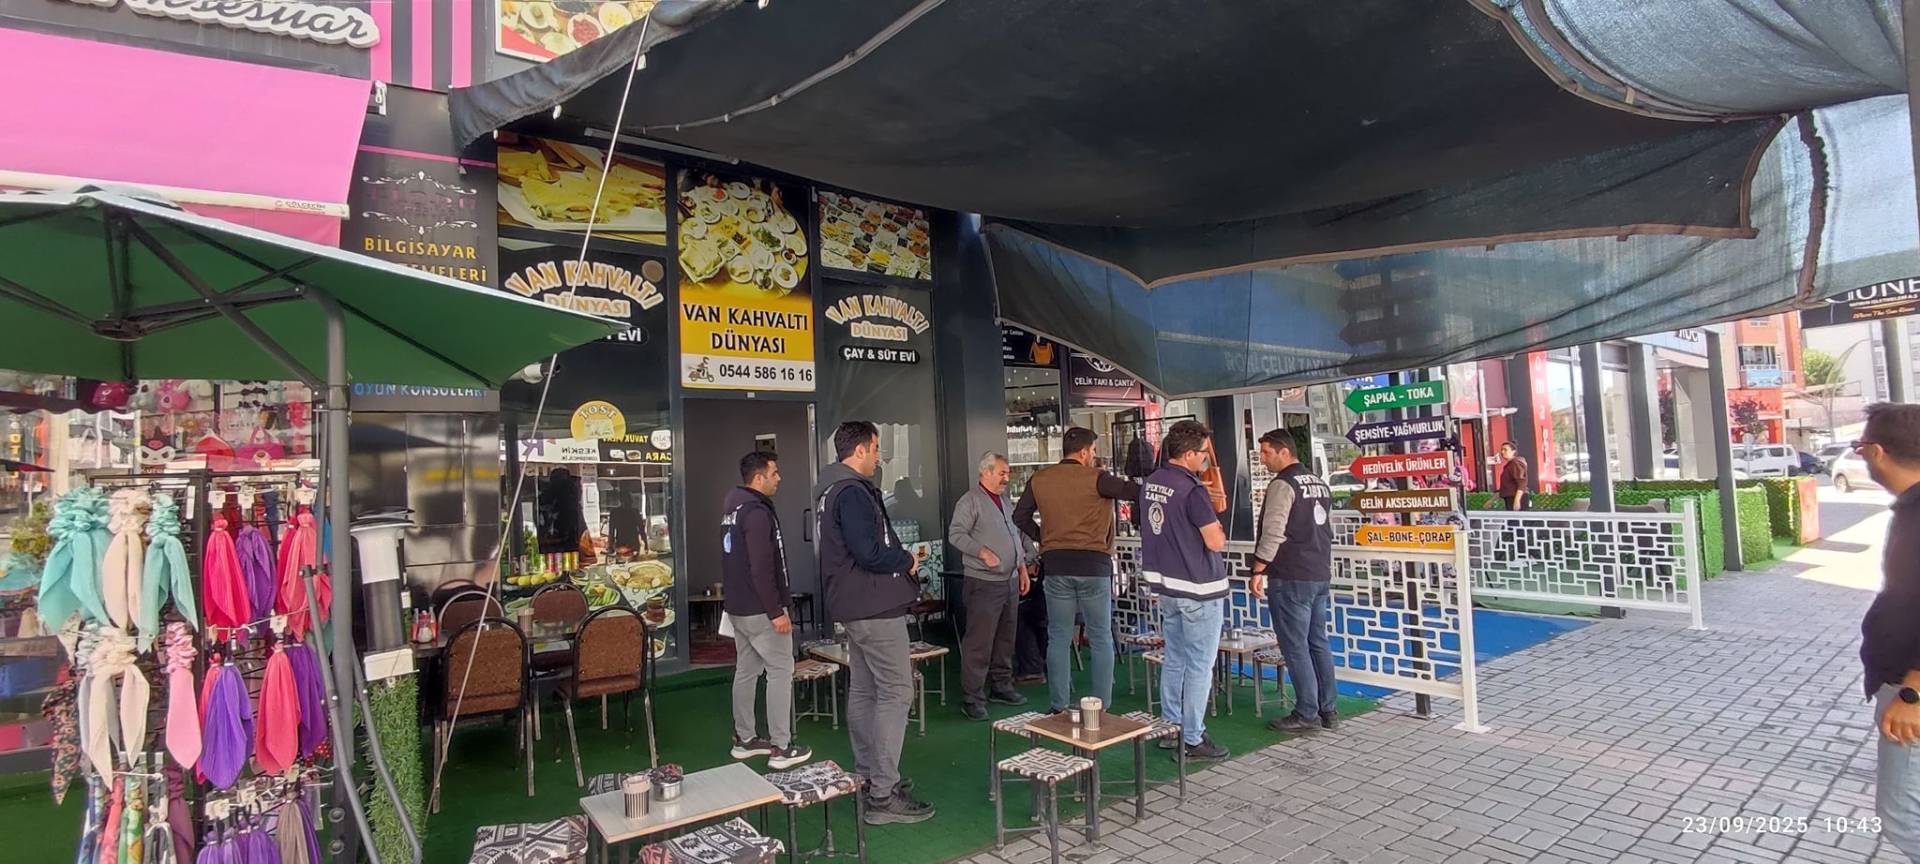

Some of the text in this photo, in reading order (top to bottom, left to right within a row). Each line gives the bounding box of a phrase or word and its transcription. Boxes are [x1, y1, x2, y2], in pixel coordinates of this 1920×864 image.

[365, 235, 476, 259] BİLGİSAYAR
[506, 261, 663, 309] VAN KAHVALTI
[683, 304, 808, 330] VAN KAHVALTI
[826, 295, 929, 334] VAN KAHVALTI
[618, 328, 641, 342] EVİ
[851, 321, 908, 341] DÜNYASI
[712, 329, 785, 353] DÜNYASI
[844, 348, 916, 362] ÇAY & SÜT EVİ
[720, 364, 812, 381] 0544 586 16 16
[1075, 377, 1092, 386] ÇELİK
[354, 383, 396, 395] OYUN
[1364, 392, 1396, 407] ŞAPKA
[1406, 387, 1434, 399] TOKA
[579, 405, 617, 420] TOST
[1355, 420, 1445, 443] ŞEMSİYE-YAĞMURLUK
[1363, 457, 1446, 475] HEDİYELİK ÜRÜNLER
[1360, 495, 1448, 509] GELİN AKSESUARLARI
